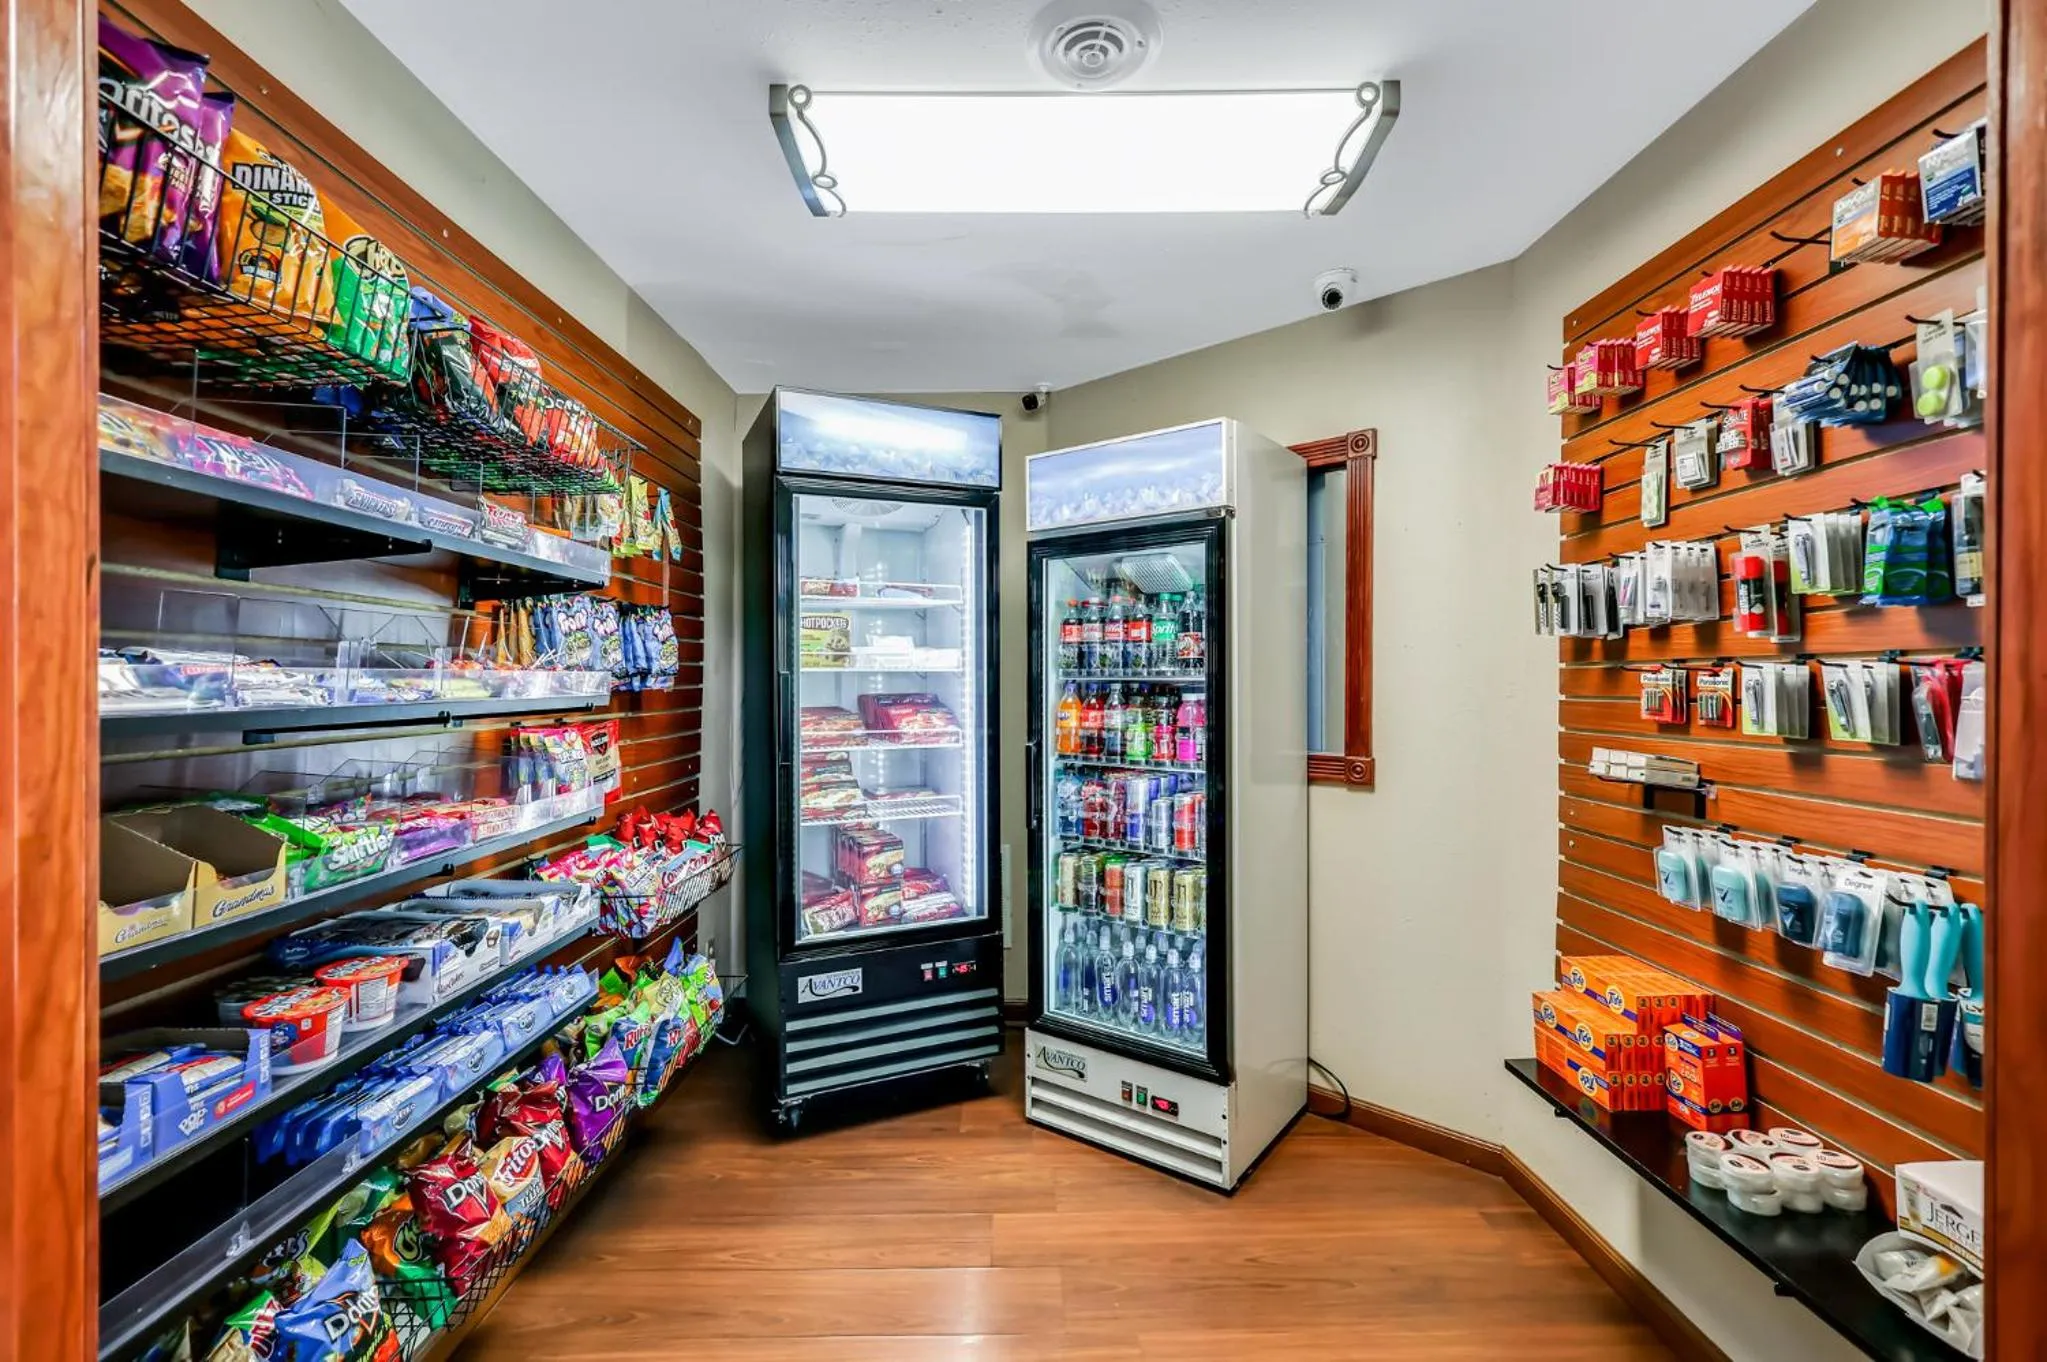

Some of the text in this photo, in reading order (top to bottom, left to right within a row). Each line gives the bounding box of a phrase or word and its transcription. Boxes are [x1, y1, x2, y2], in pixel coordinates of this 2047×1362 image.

[1844, 877, 1874, 891] Degree
[801, 974, 861, 997] AVANTCO
[1037, 1046, 1086, 1079] AVANTCO
